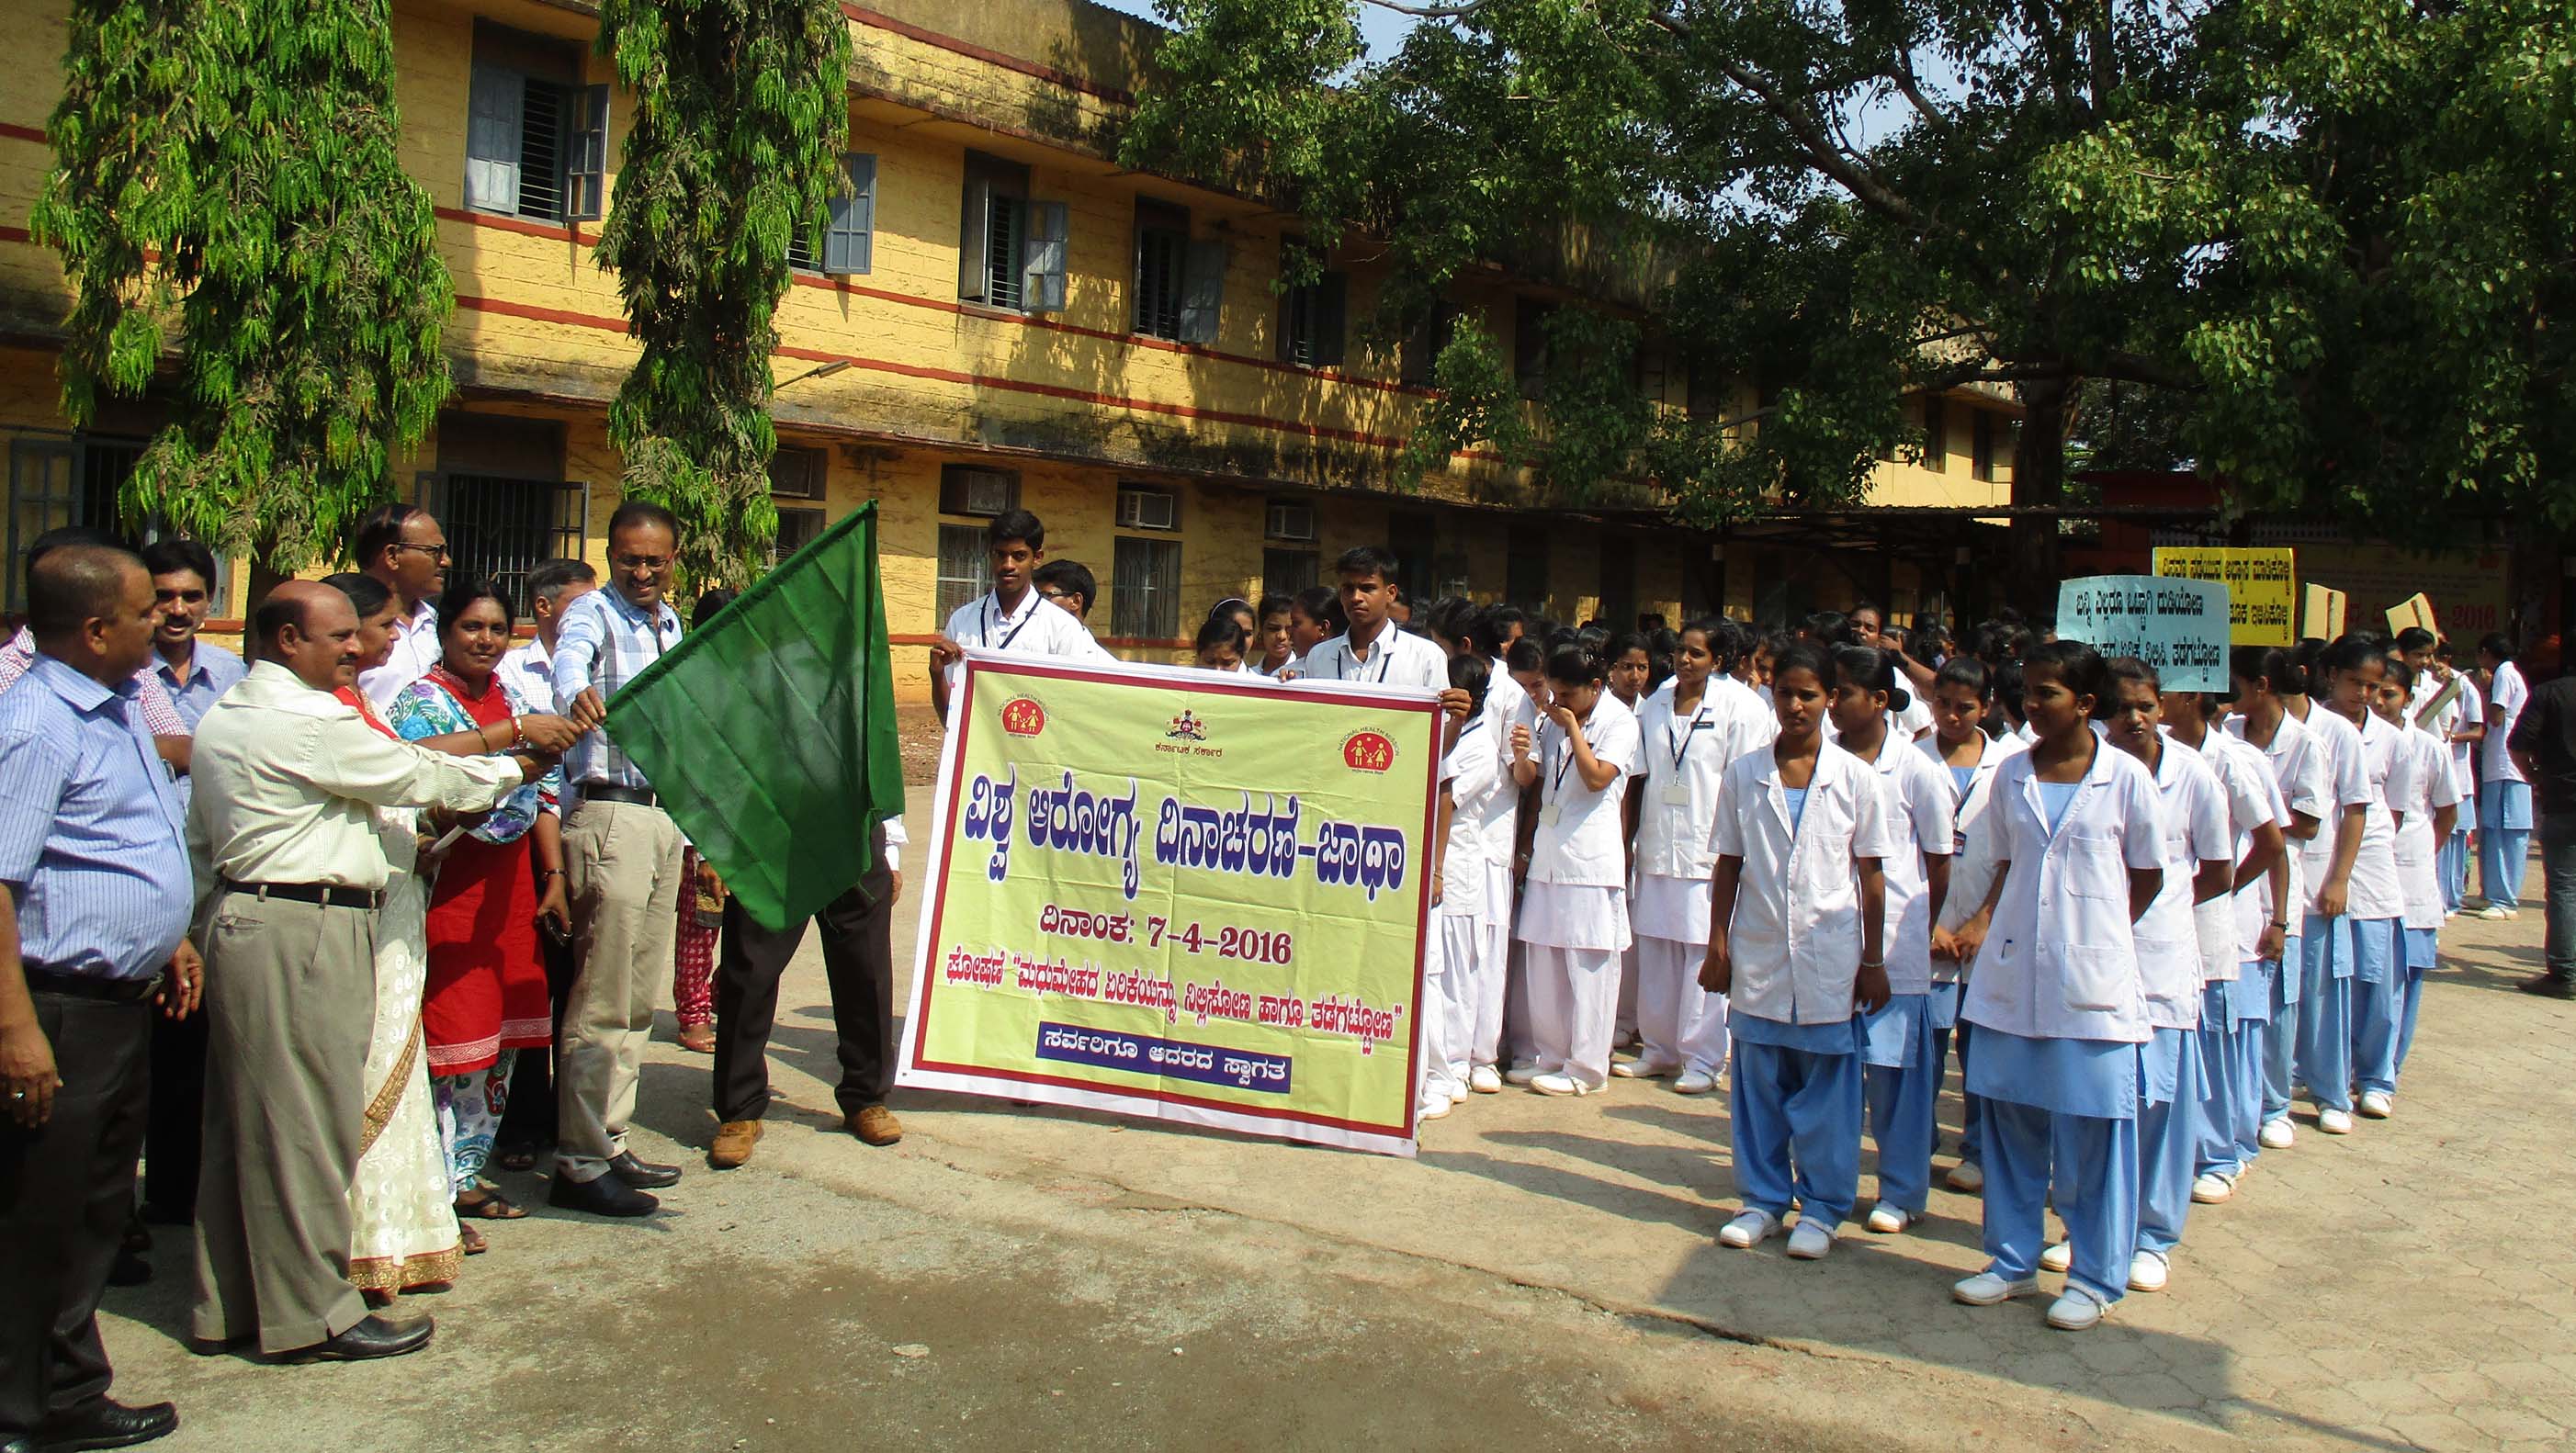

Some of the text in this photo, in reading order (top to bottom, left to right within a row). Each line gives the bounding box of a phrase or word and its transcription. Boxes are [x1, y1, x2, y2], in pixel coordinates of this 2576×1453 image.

[1154, 741, 1224, 758] ಕರ್ನಾಟಕ ಸರ್ಕಾರ
[1337, 728, 1360, 751] NATIONAL
[1360, 726, 1384, 735] HEALTH
[965, 762, 1016, 882] ವಿಶ್ವ
[1028, 771, 1141, 900] ಆರೋಗ್ಯ
[1040, 904, 1293, 964] ದಿನಾಂಕ: 7-4-2016
[946, 945, 1006, 990] ಘೋಷಣೆ
[1104, 968, 1178, 1024] ಏರಿಕೆಯನ್ನು
[1184, 980, 1251, 1027] ನಿಲ್ಲಿಸೋಣ
[1258, 986, 1304, 1028] ಹಾಗೂ
[1044, 1028, 1286, 1086] ಸರ್ವರಿಗೂ ಆದರದ ಸ್ವಾಗತ
